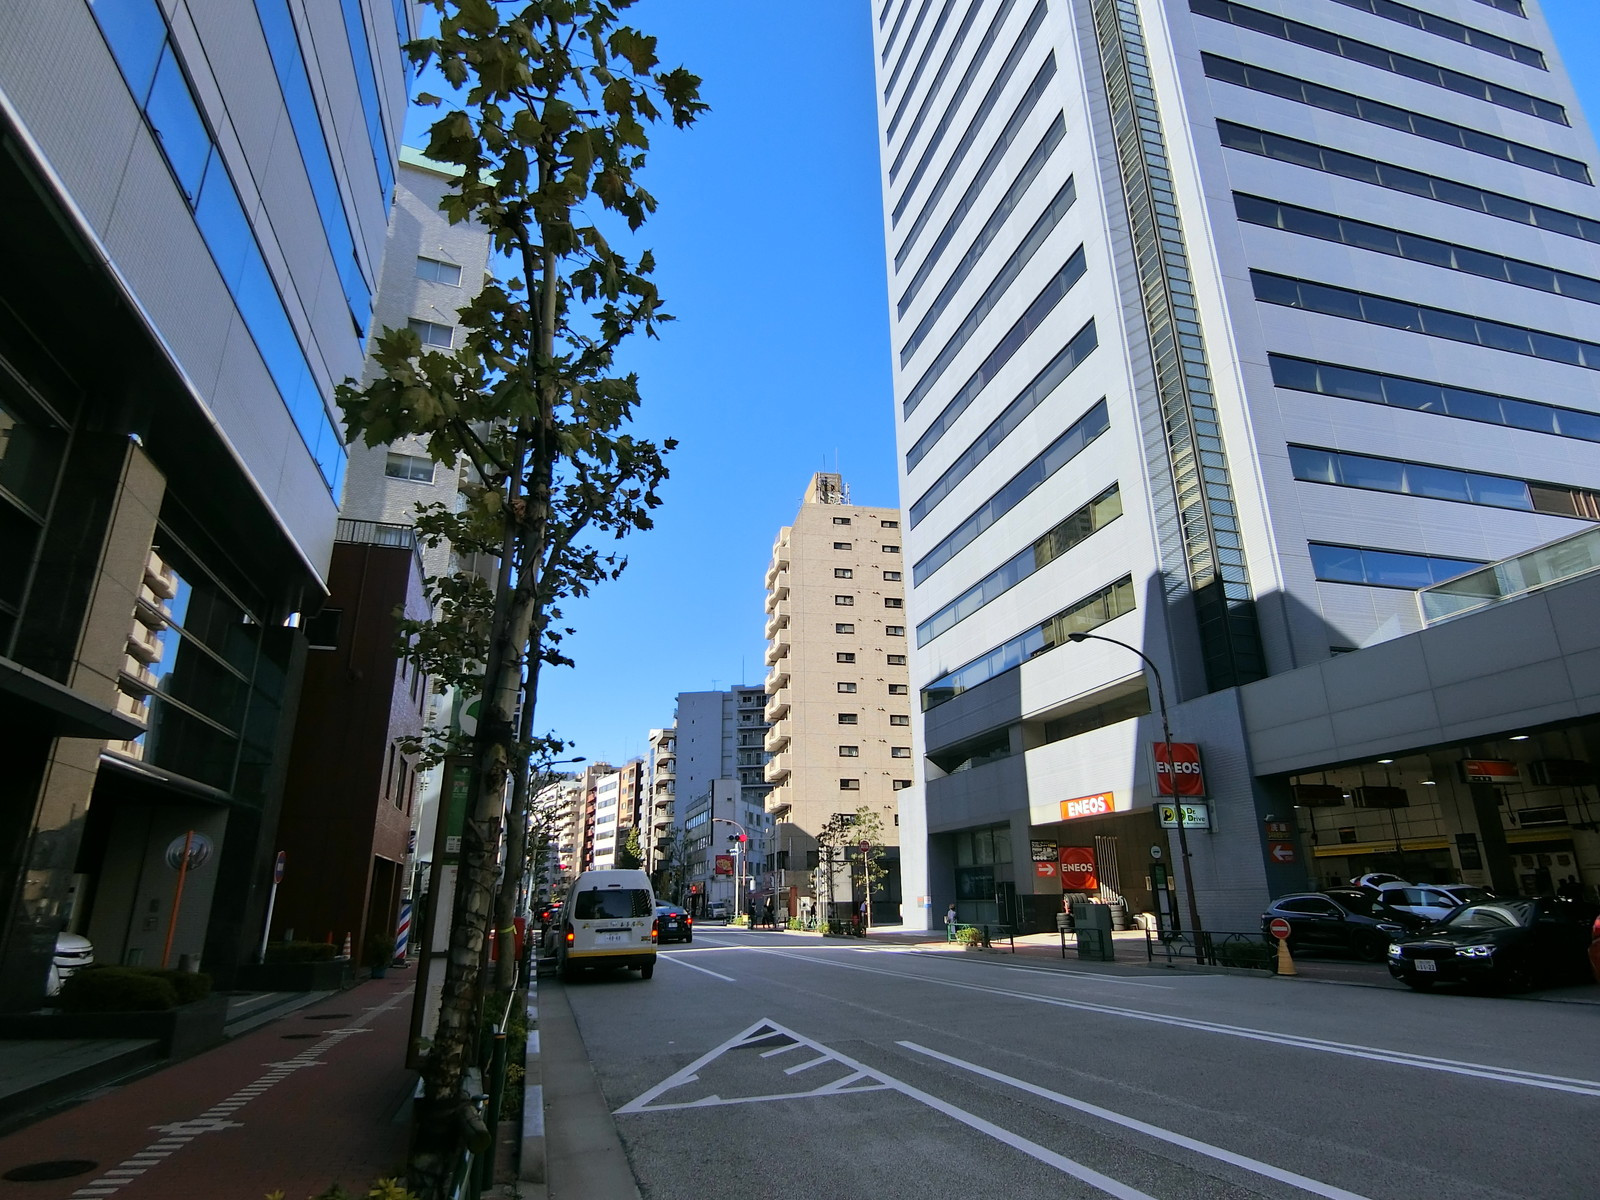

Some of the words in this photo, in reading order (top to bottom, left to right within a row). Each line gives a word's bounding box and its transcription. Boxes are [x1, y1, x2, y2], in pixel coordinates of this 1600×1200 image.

[1156, 762, 1200, 774] ENEOS
[1067, 796, 1106, 817] ENEOS
[1187, 815, 1206, 823] Drive
[1061, 863, 1093, 872] ENEOS
